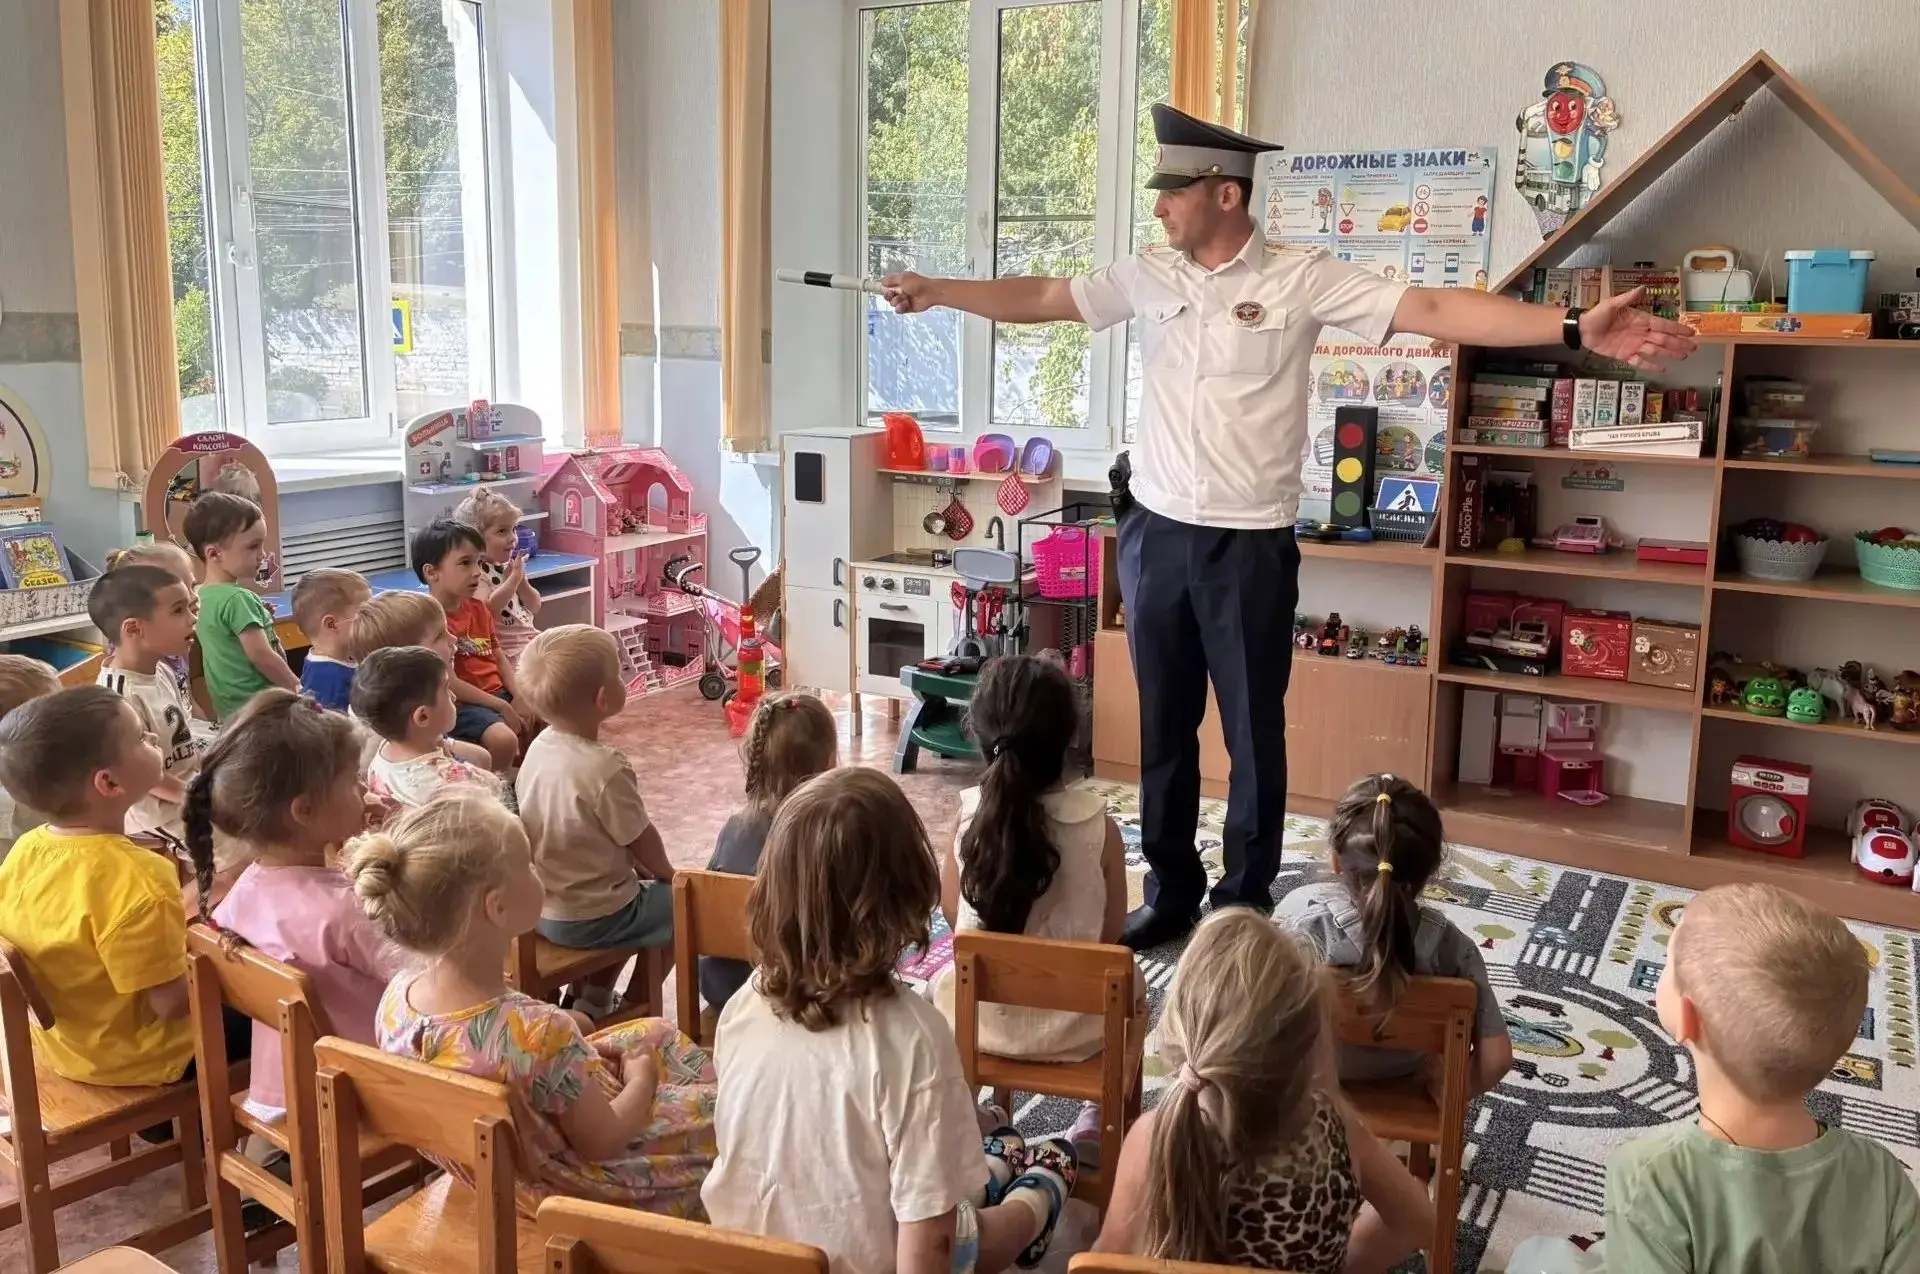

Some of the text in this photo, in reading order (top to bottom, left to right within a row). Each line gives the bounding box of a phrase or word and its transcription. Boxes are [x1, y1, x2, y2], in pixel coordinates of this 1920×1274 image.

[1291, 150, 1466, 173] ДОРОЖНЫЕ ЗНАКИ
[1333, 345, 1403, 357] ДОРОЖНОГО
[1405, 347, 1452, 359] ДВИЖЕ
[196, 433, 225, 442] САЛОН
[192, 441, 230, 451] КРАСОТЫ
[23, 576, 60, 588] СКАЗКИ
